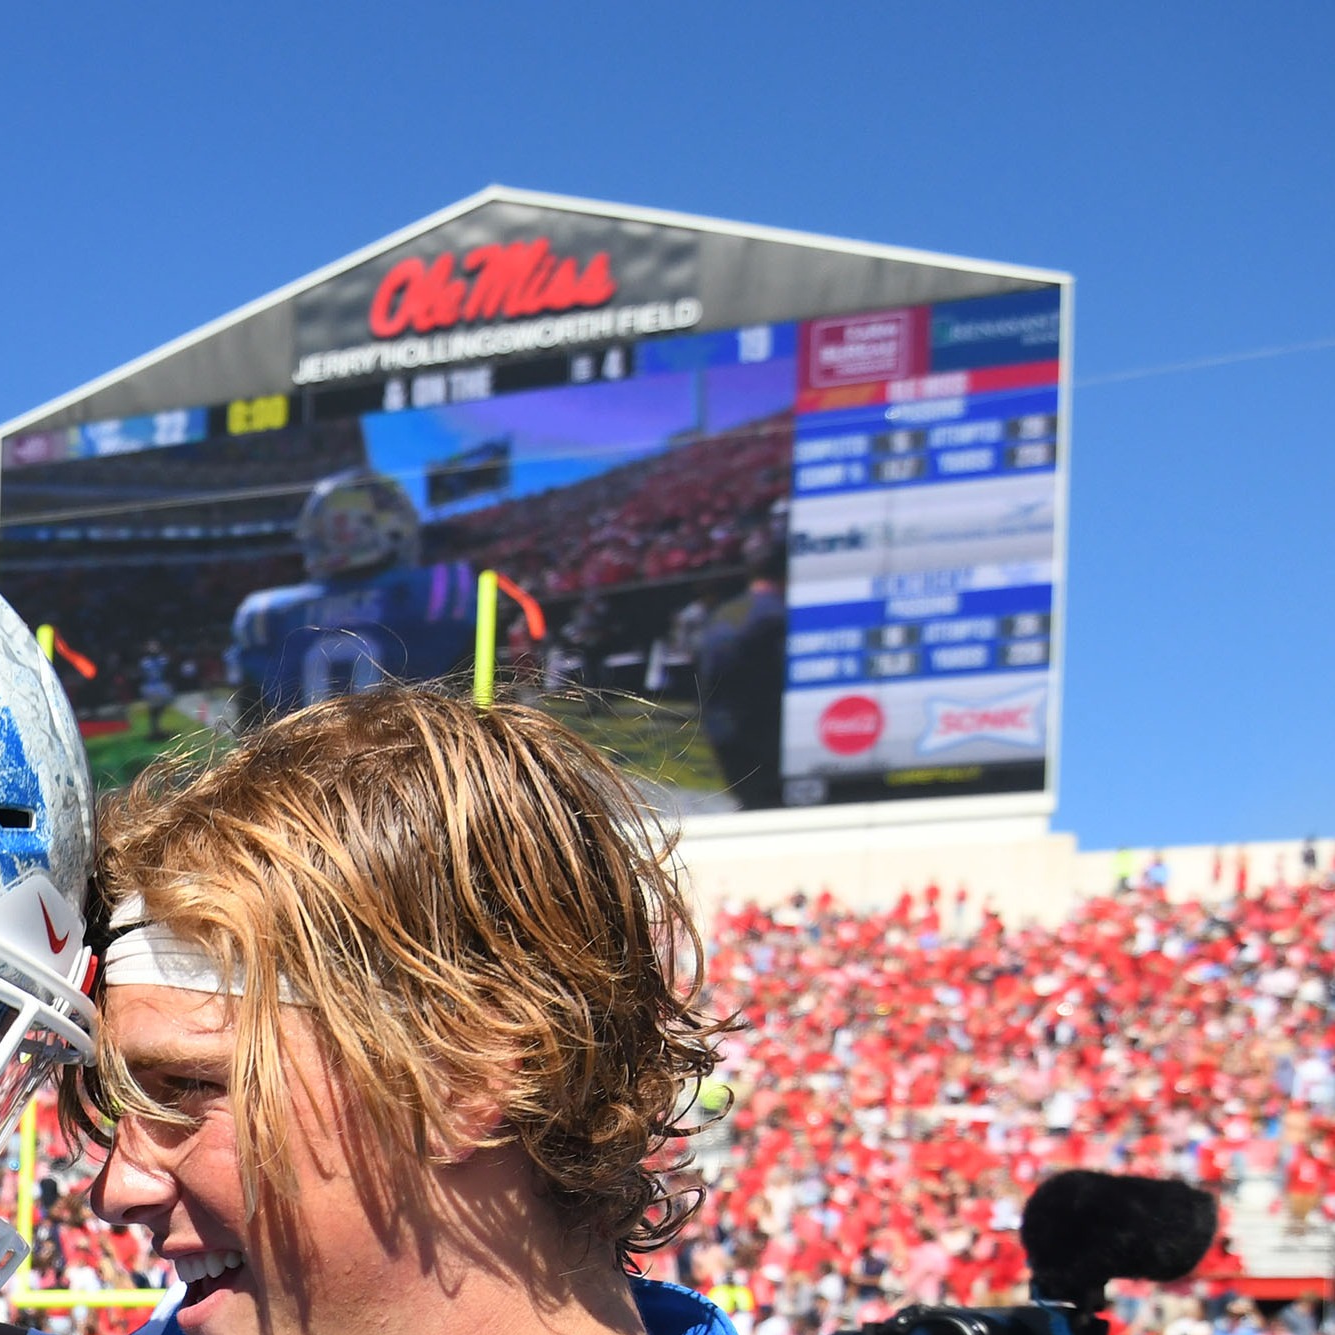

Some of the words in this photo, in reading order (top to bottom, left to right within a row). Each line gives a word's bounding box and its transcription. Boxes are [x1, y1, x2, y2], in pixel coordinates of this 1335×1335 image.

[368, 251, 466, 338] Ole
[464, 236, 618, 320] Miss
[293, 343, 381, 385] JERRY
[378, 309, 615, 370] HOLLINGSWORTH
[615, 298, 703, 335] FIELD
